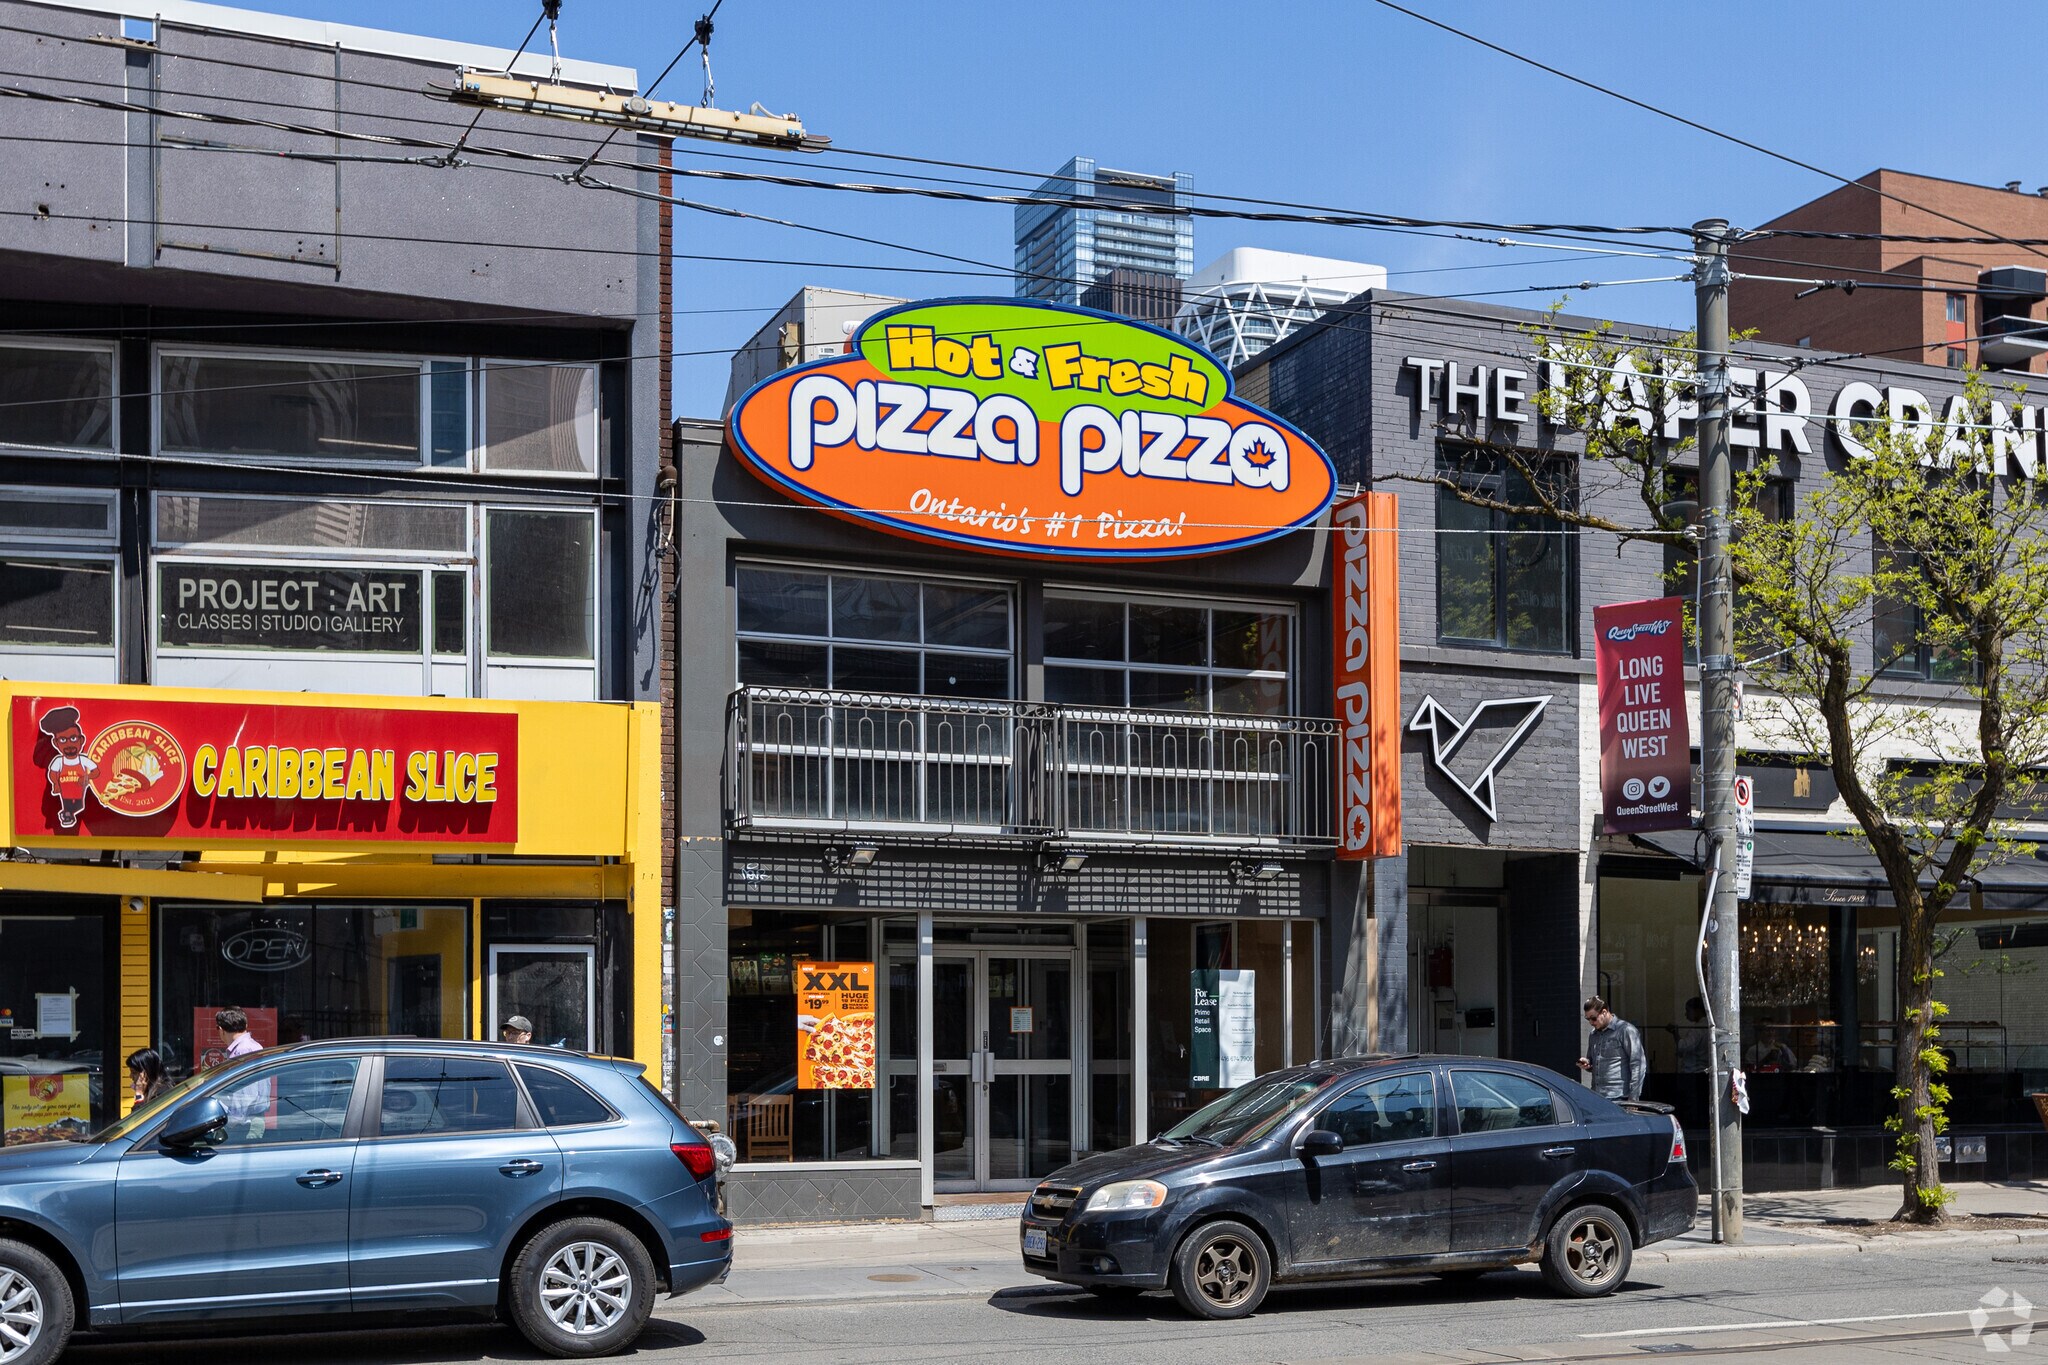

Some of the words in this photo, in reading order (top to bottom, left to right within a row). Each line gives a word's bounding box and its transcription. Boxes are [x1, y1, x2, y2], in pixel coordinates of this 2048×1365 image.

[886, 325, 1002, 379] Hot
[1009, 346, 1039, 379] &
[1044, 342, 1209, 407] Fresh
[1404, 355, 1529, 423] THE
[1835, 381, 2048, 480] CRAN
[909, 488, 1036, 535] Ontario's
[1045, 511, 1082, 538] #1
[1097, 510, 1186, 539] Pizza!
[178, 578, 319, 612] PROJECT
[345, 582, 406, 613] ART
[177, 612, 252, 631] CLASSES
[261, 614, 322, 632] STUDIO
[330, 616, 405, 633] GALLERY
[1618, 655, 1664, 681] LONG
[1624, 682, 1661, 706] LIVE
[1616, 708, 1671, 733] QUEEN
[91, 727, 151, 763] CARIBBEAN
[153, 735, 180, 765] SLICE
[1621, 735, 1669, 760] WEST
[193, 743, 395, 800] CARIBBEAN
[405, 750, 498, 803] SLICE
[1616, 802, 1678, 816] QueenStreetWest
[1823, 888, 1846, 902] Since
[227, 938, 309, 960] OPEN
[803, 972, 870, 991] XXL
[1195, 988, 1208, 998] For
[1194, 997, 1218, 1006] Lease
